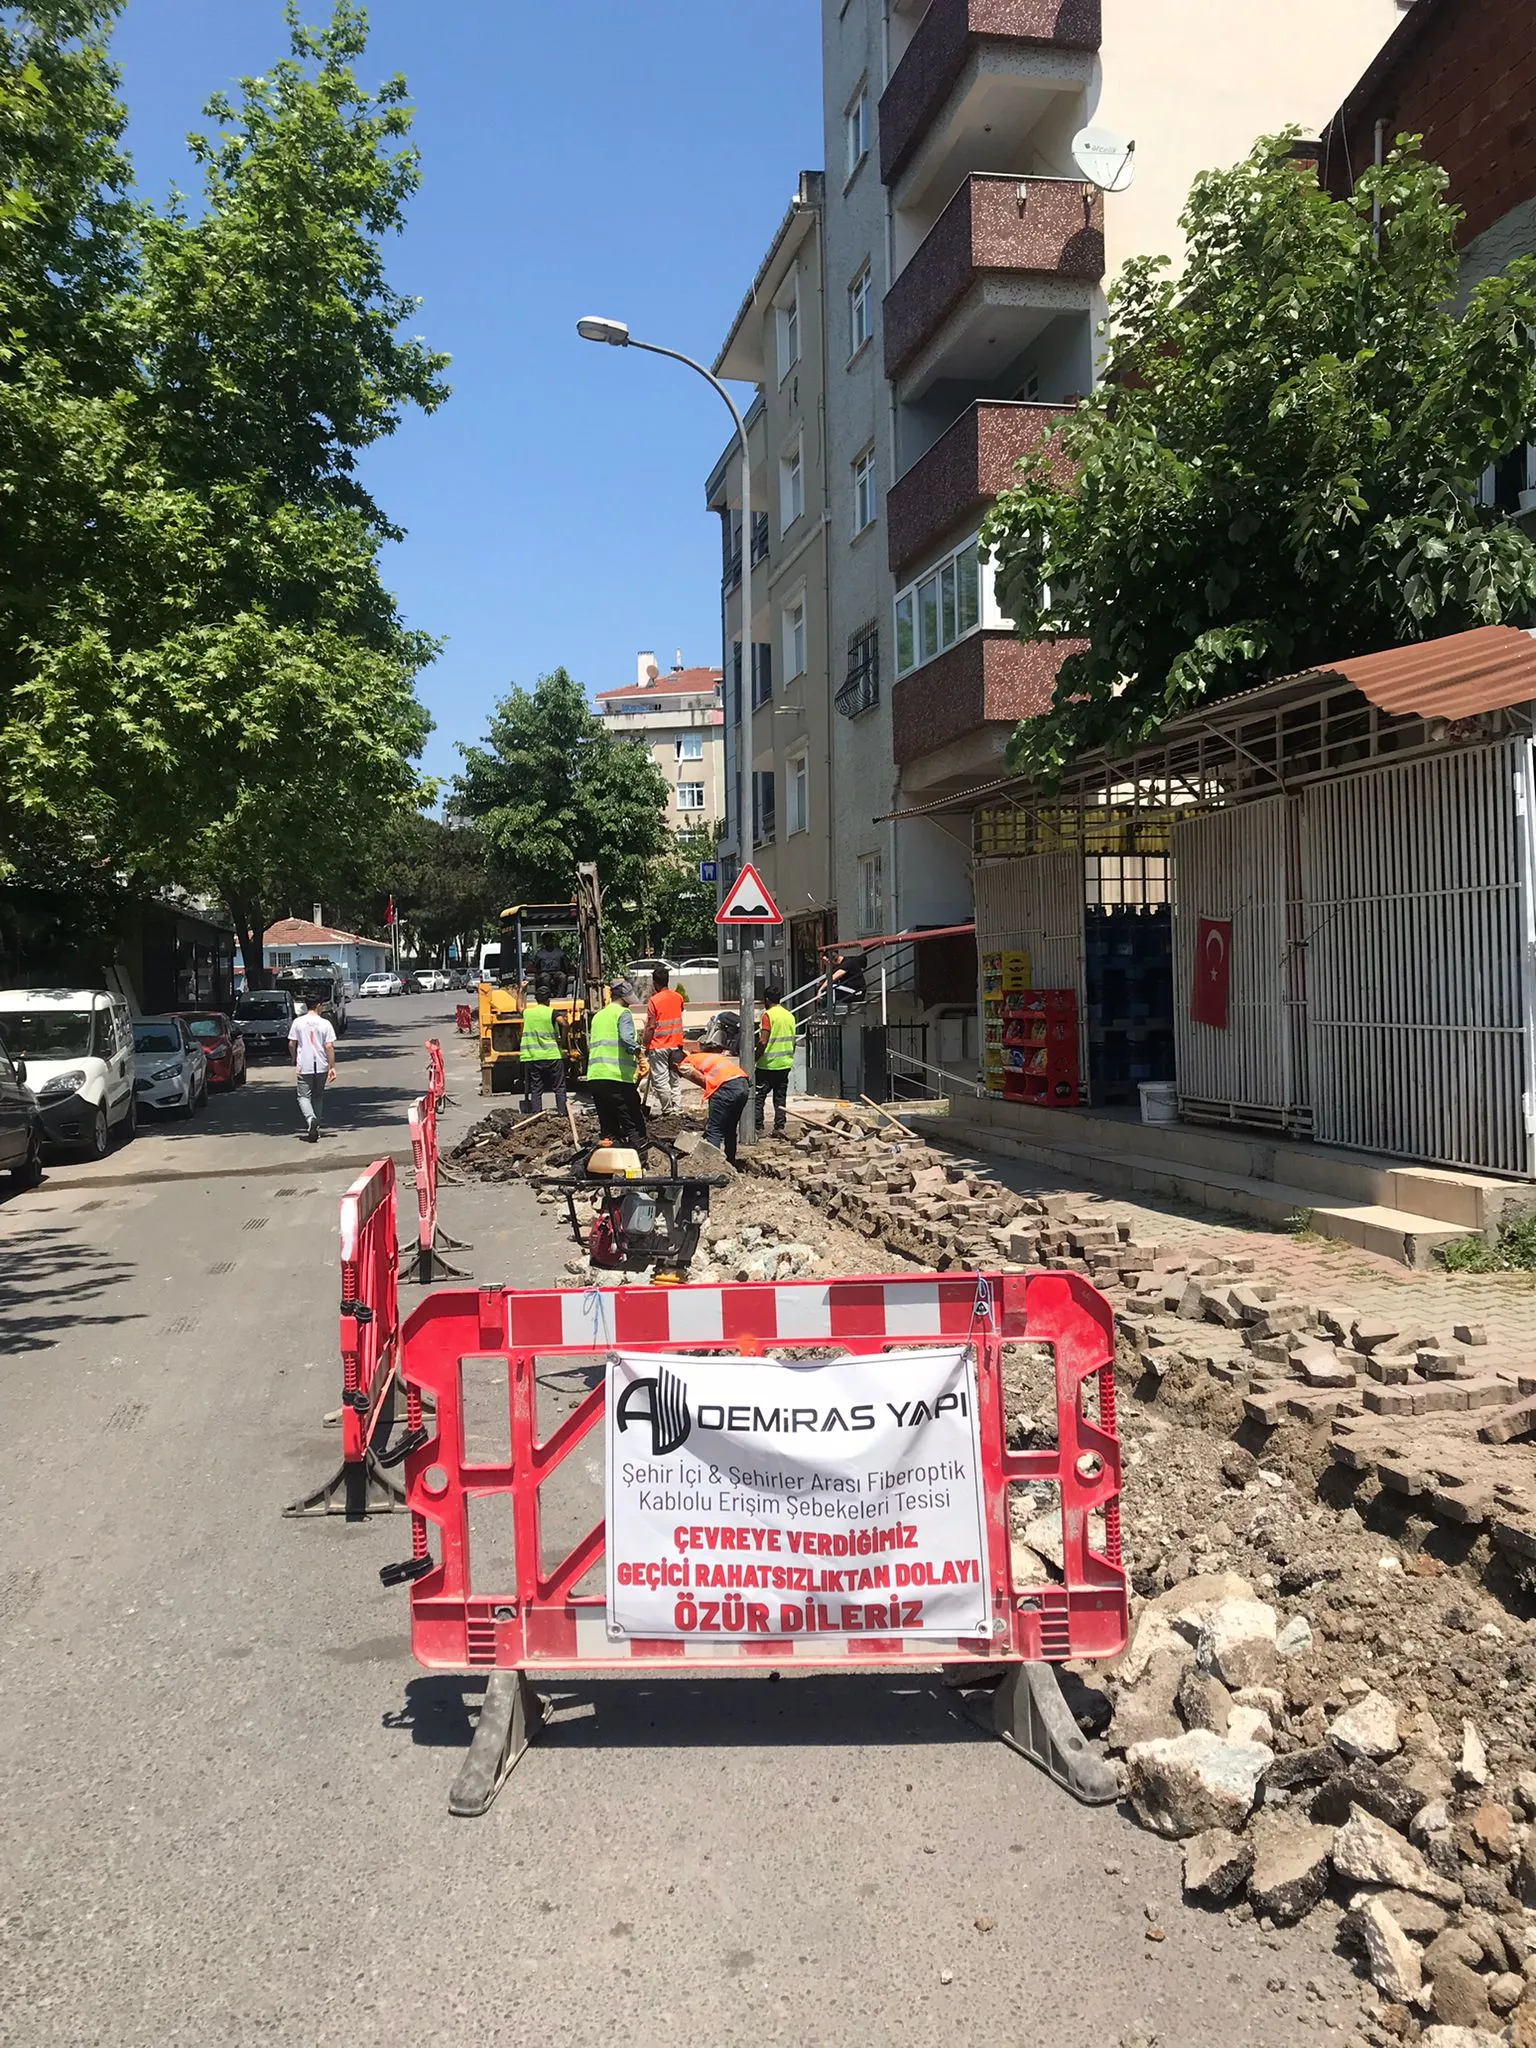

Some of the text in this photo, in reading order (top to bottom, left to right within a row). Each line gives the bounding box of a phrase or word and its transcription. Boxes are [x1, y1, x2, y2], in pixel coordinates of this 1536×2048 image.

[886, 1392, 968, 1428] YAPI
[622, 1459, 966, 1493] Şehir İçi & Şehirler Arası Fiberoptik
[639, 1488, 950, 1520] Kablolu Erişim Şebekeleri Tesisi
[674, 1521, 918, 1557] ÇEVREYE VERDİĞİMİZ
[617, 1557, 980, 1592] GEÇİCİ RAHATSIZLIKTAN DOLAYI
[674, 1592, 923, 1632] ÖZÜR DİLERİZ
